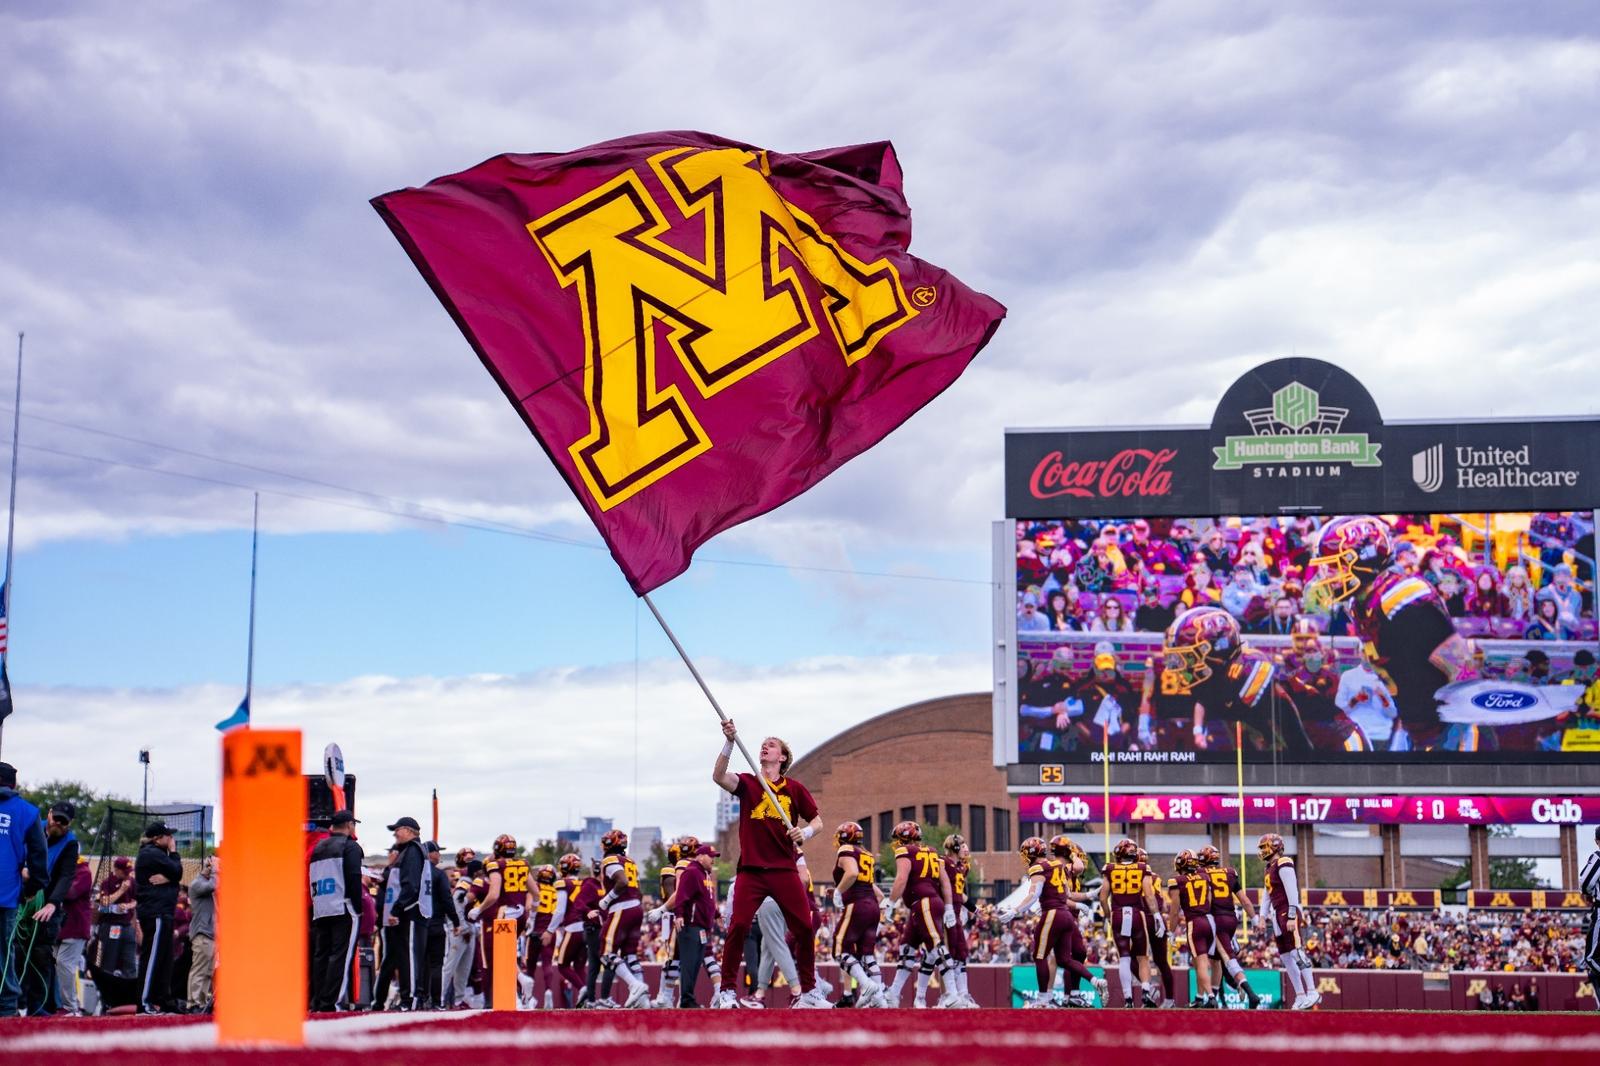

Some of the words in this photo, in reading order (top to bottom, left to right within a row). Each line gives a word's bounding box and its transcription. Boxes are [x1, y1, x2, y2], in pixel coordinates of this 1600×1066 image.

[526, 146, 920, 513] M
[1234, 440, 1319, 459] Huntington
[1321, 438, 1360, 455] Bank
[1456, 445, 1530, 467] United
[1029, 449, 1178, 499] Coca-Cola
[1253, 465, 1341, 478] STADIUM
[1456, 467, 1578, 489] Healthcare
[1484, 693, 1524, 708] Ford
[1090, 751, 1116, 762] RAH!
[1117, 751, 1142, 762] RAH!
[1143, 751, 1169, 762] RAH!
[1170, 751, 1196, 762] RAH!
[1041, 766, 1063, 783] 25
[1041, 796, 1090, 821] Cub
[1289, 798, 1332, 821] 1:07
[1351, 808, 1357, 820] 1
[1432, 799, 1445, 820] 0
[1531, 798, 1583, 822] Cub
[915, 851, 941, 878] 76
[503, 866, 530, 892] 82
[1110, 869, 1143, 895] 88
[1185, 879, 1208, 907] 17
